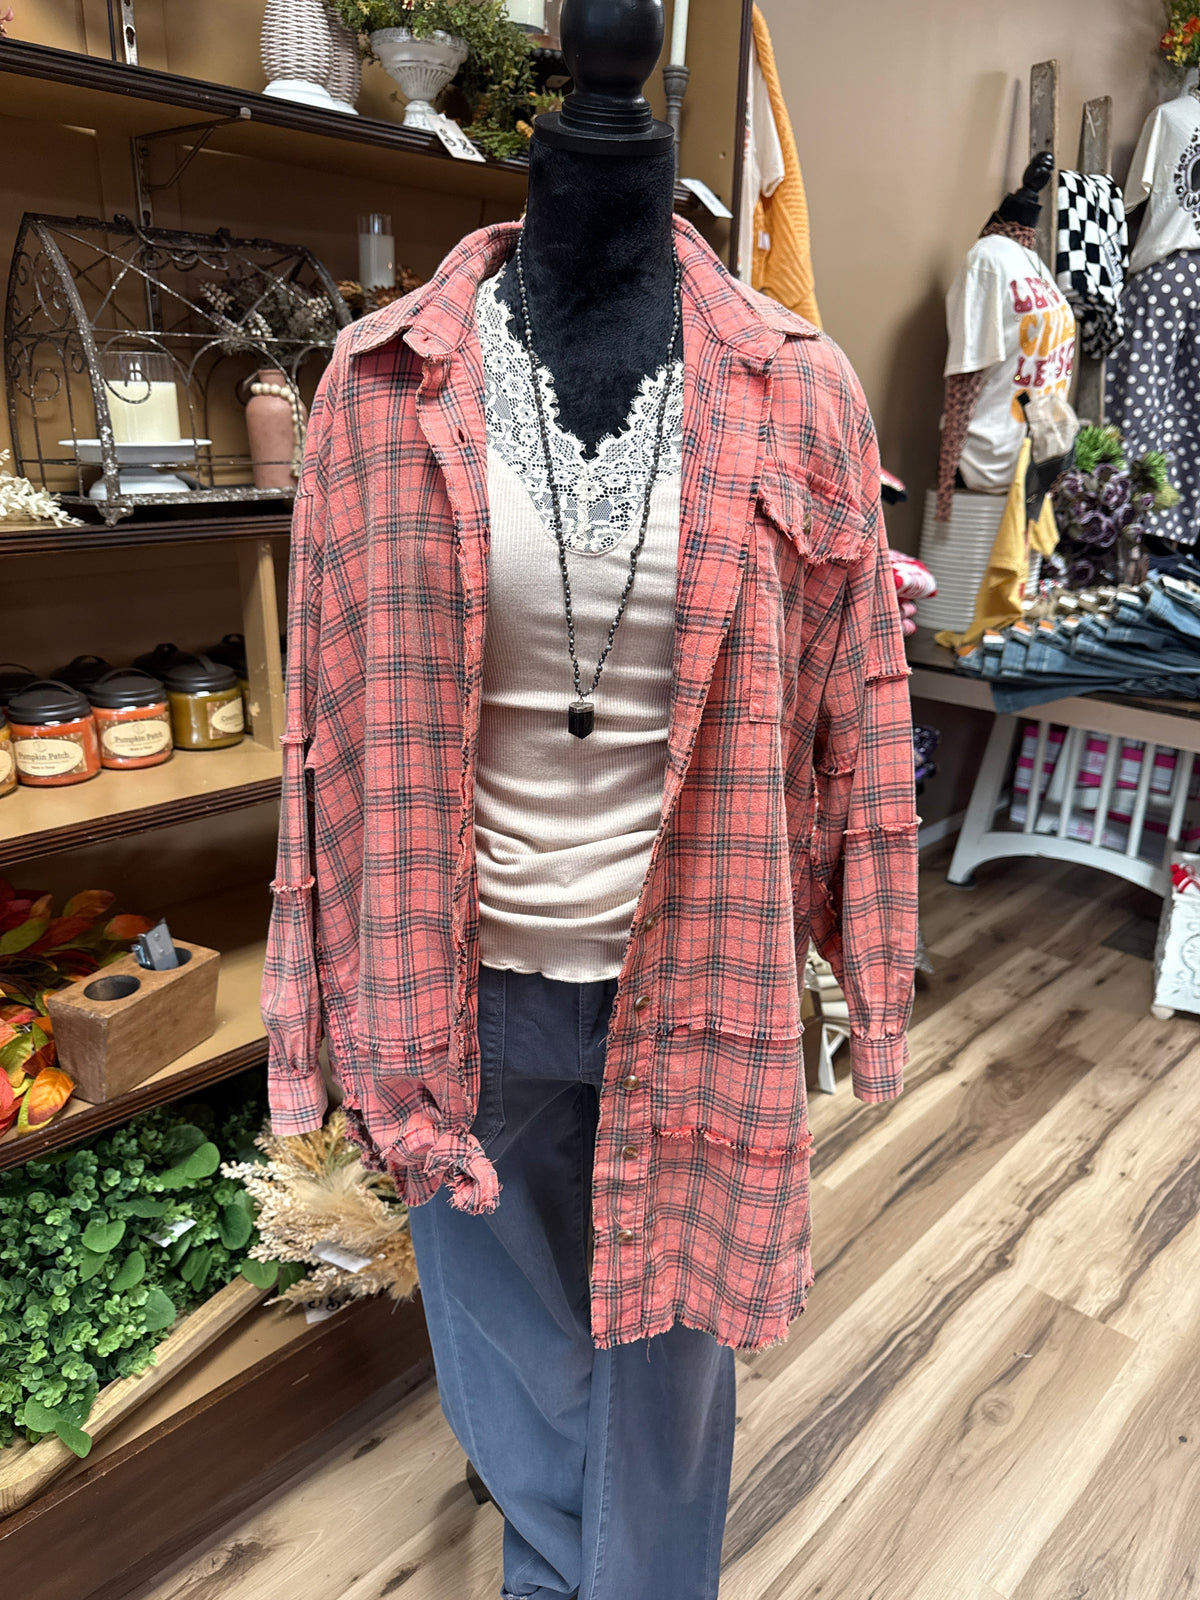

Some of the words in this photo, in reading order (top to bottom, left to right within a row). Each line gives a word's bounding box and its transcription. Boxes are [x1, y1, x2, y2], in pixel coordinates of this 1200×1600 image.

[114, 735, 146, 744] Pumpkin
[146, 731, 164, 740] Patch
[18, 752, 47, 762] Pumpkin
[48, 752, 70, 760] Patch
